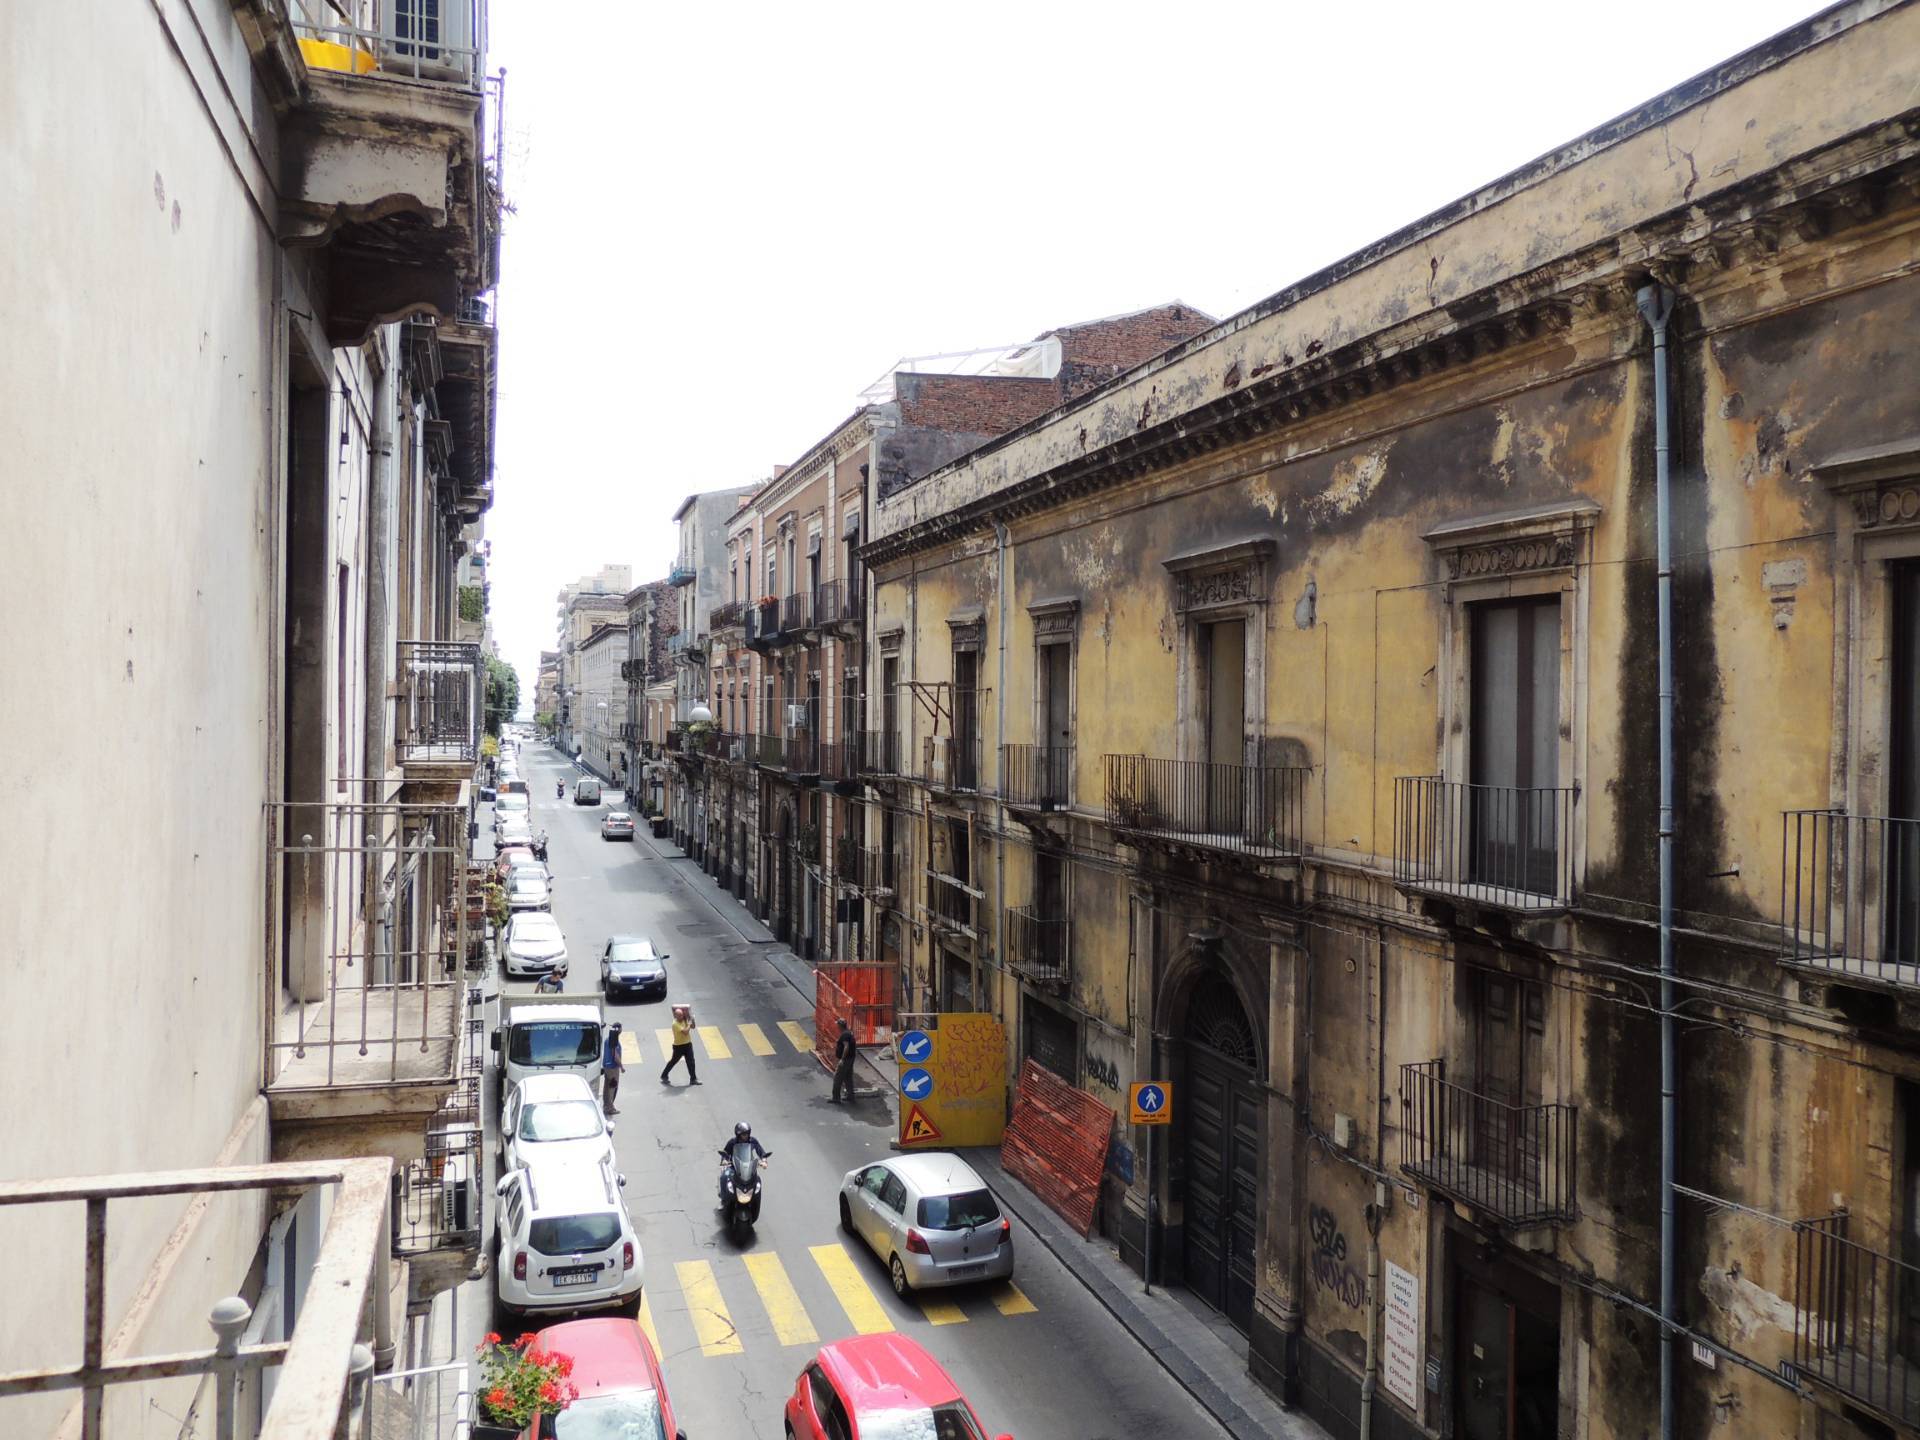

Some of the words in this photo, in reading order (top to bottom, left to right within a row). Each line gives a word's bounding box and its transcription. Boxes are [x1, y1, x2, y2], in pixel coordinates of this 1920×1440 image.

[1391, 1268, 1413, 1287] Lavori
[1391, 1281, 1412, 1298] conto
[1386, 1299, 1410, 1320] Lettere
[1394, 1293, 1409, 1307] terzi
[1389, 1313, 1414, 1334] scatola
[1391, 1351, 1411, 1371] Rame
[1389, 1366, 1412, 1387] Ottone
[1389, 1379, 1414, 1403] Acciaio
